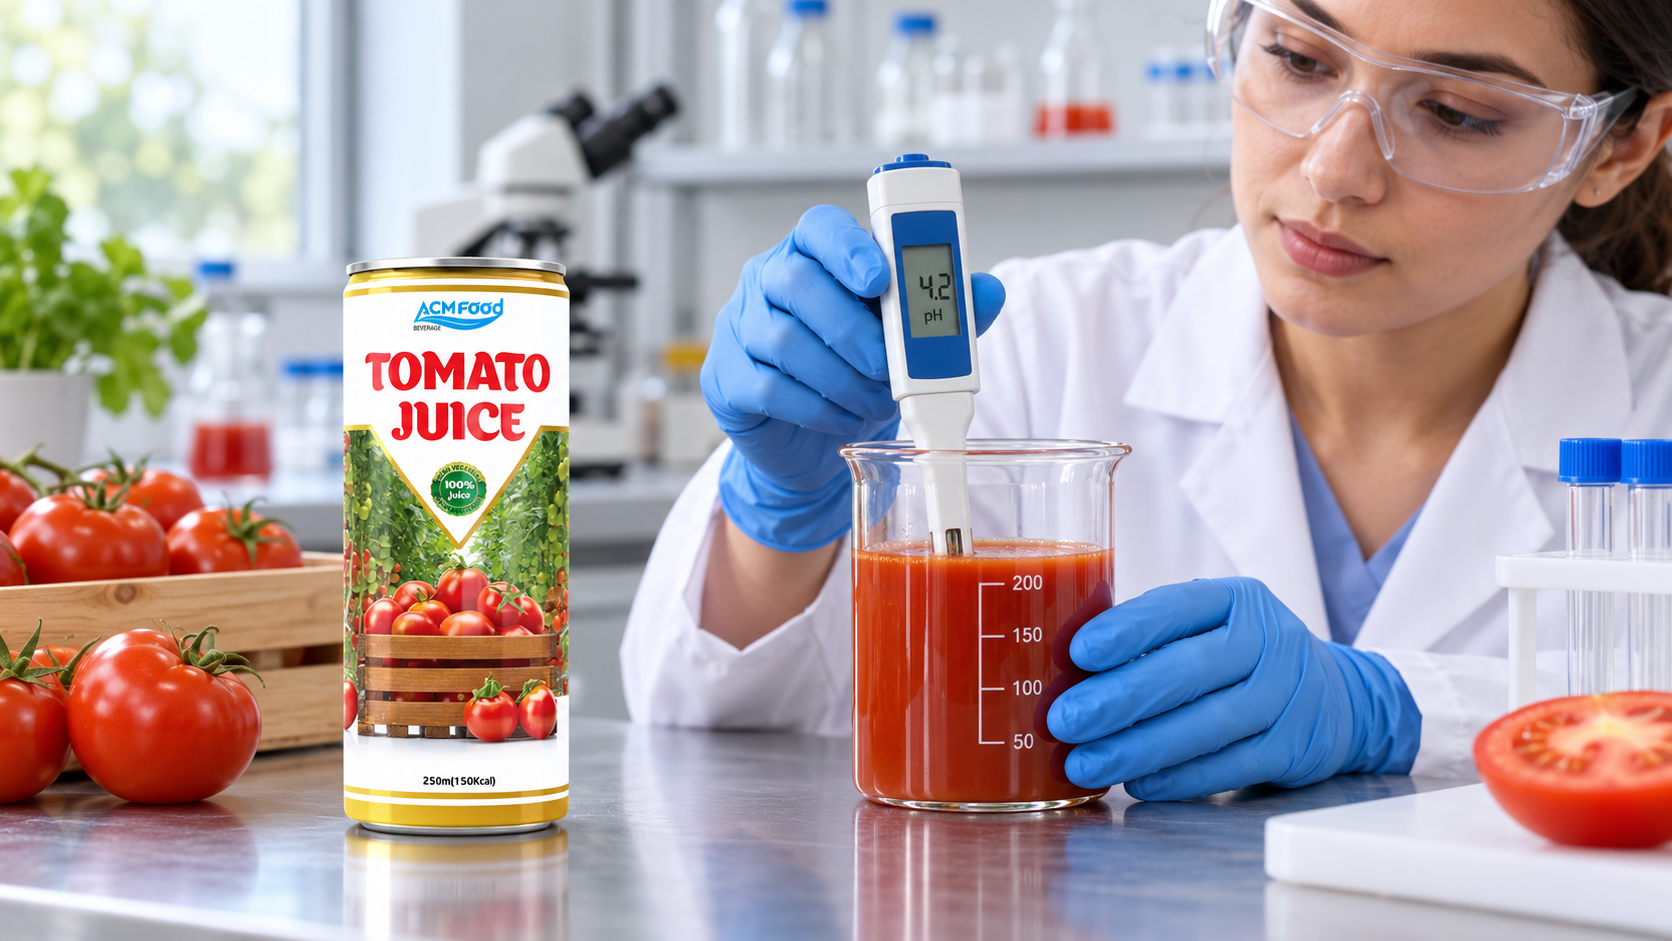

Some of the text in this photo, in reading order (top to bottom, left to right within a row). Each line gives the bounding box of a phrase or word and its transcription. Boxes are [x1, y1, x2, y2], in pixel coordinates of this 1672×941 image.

[919, 273, 951, 301] 4.2
[924, 308, 943, 325] pH
[365, 351, 551, 393] TOMATO
[391, 401, 526, 442] JUICE
[445, 480, 475, 489] 100%
[1012, 574, 1043, 591] 200
[1012, 626, 1043, 643] 150
[1012, 679, 1043, 696] 100
[1013, 733, 1034, 750] 50
